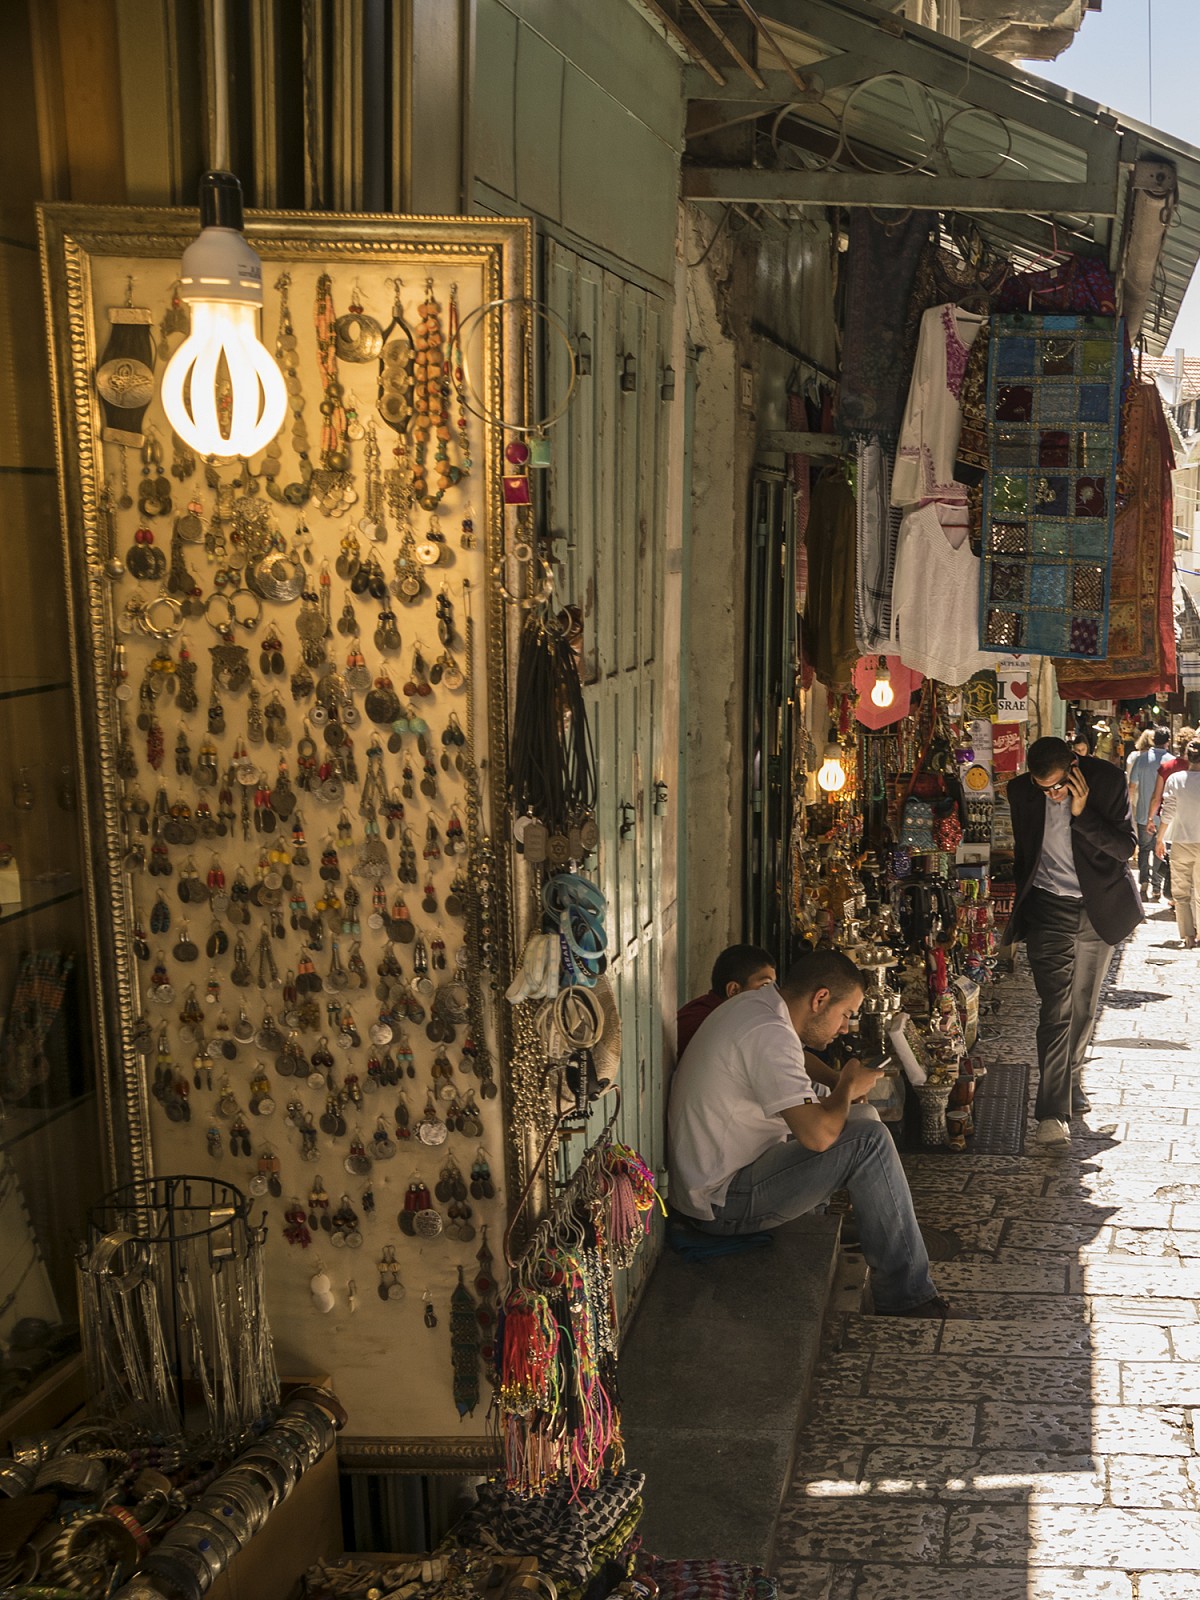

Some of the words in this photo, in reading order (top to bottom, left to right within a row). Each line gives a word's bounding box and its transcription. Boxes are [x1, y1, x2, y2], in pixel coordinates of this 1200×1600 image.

[997, 681, 1007, 700] I
[998, 701, 1026, 710] SRAE
[993, 900, 1014, 912] ALE
[561, 940, 574, 970] ISRAEL
